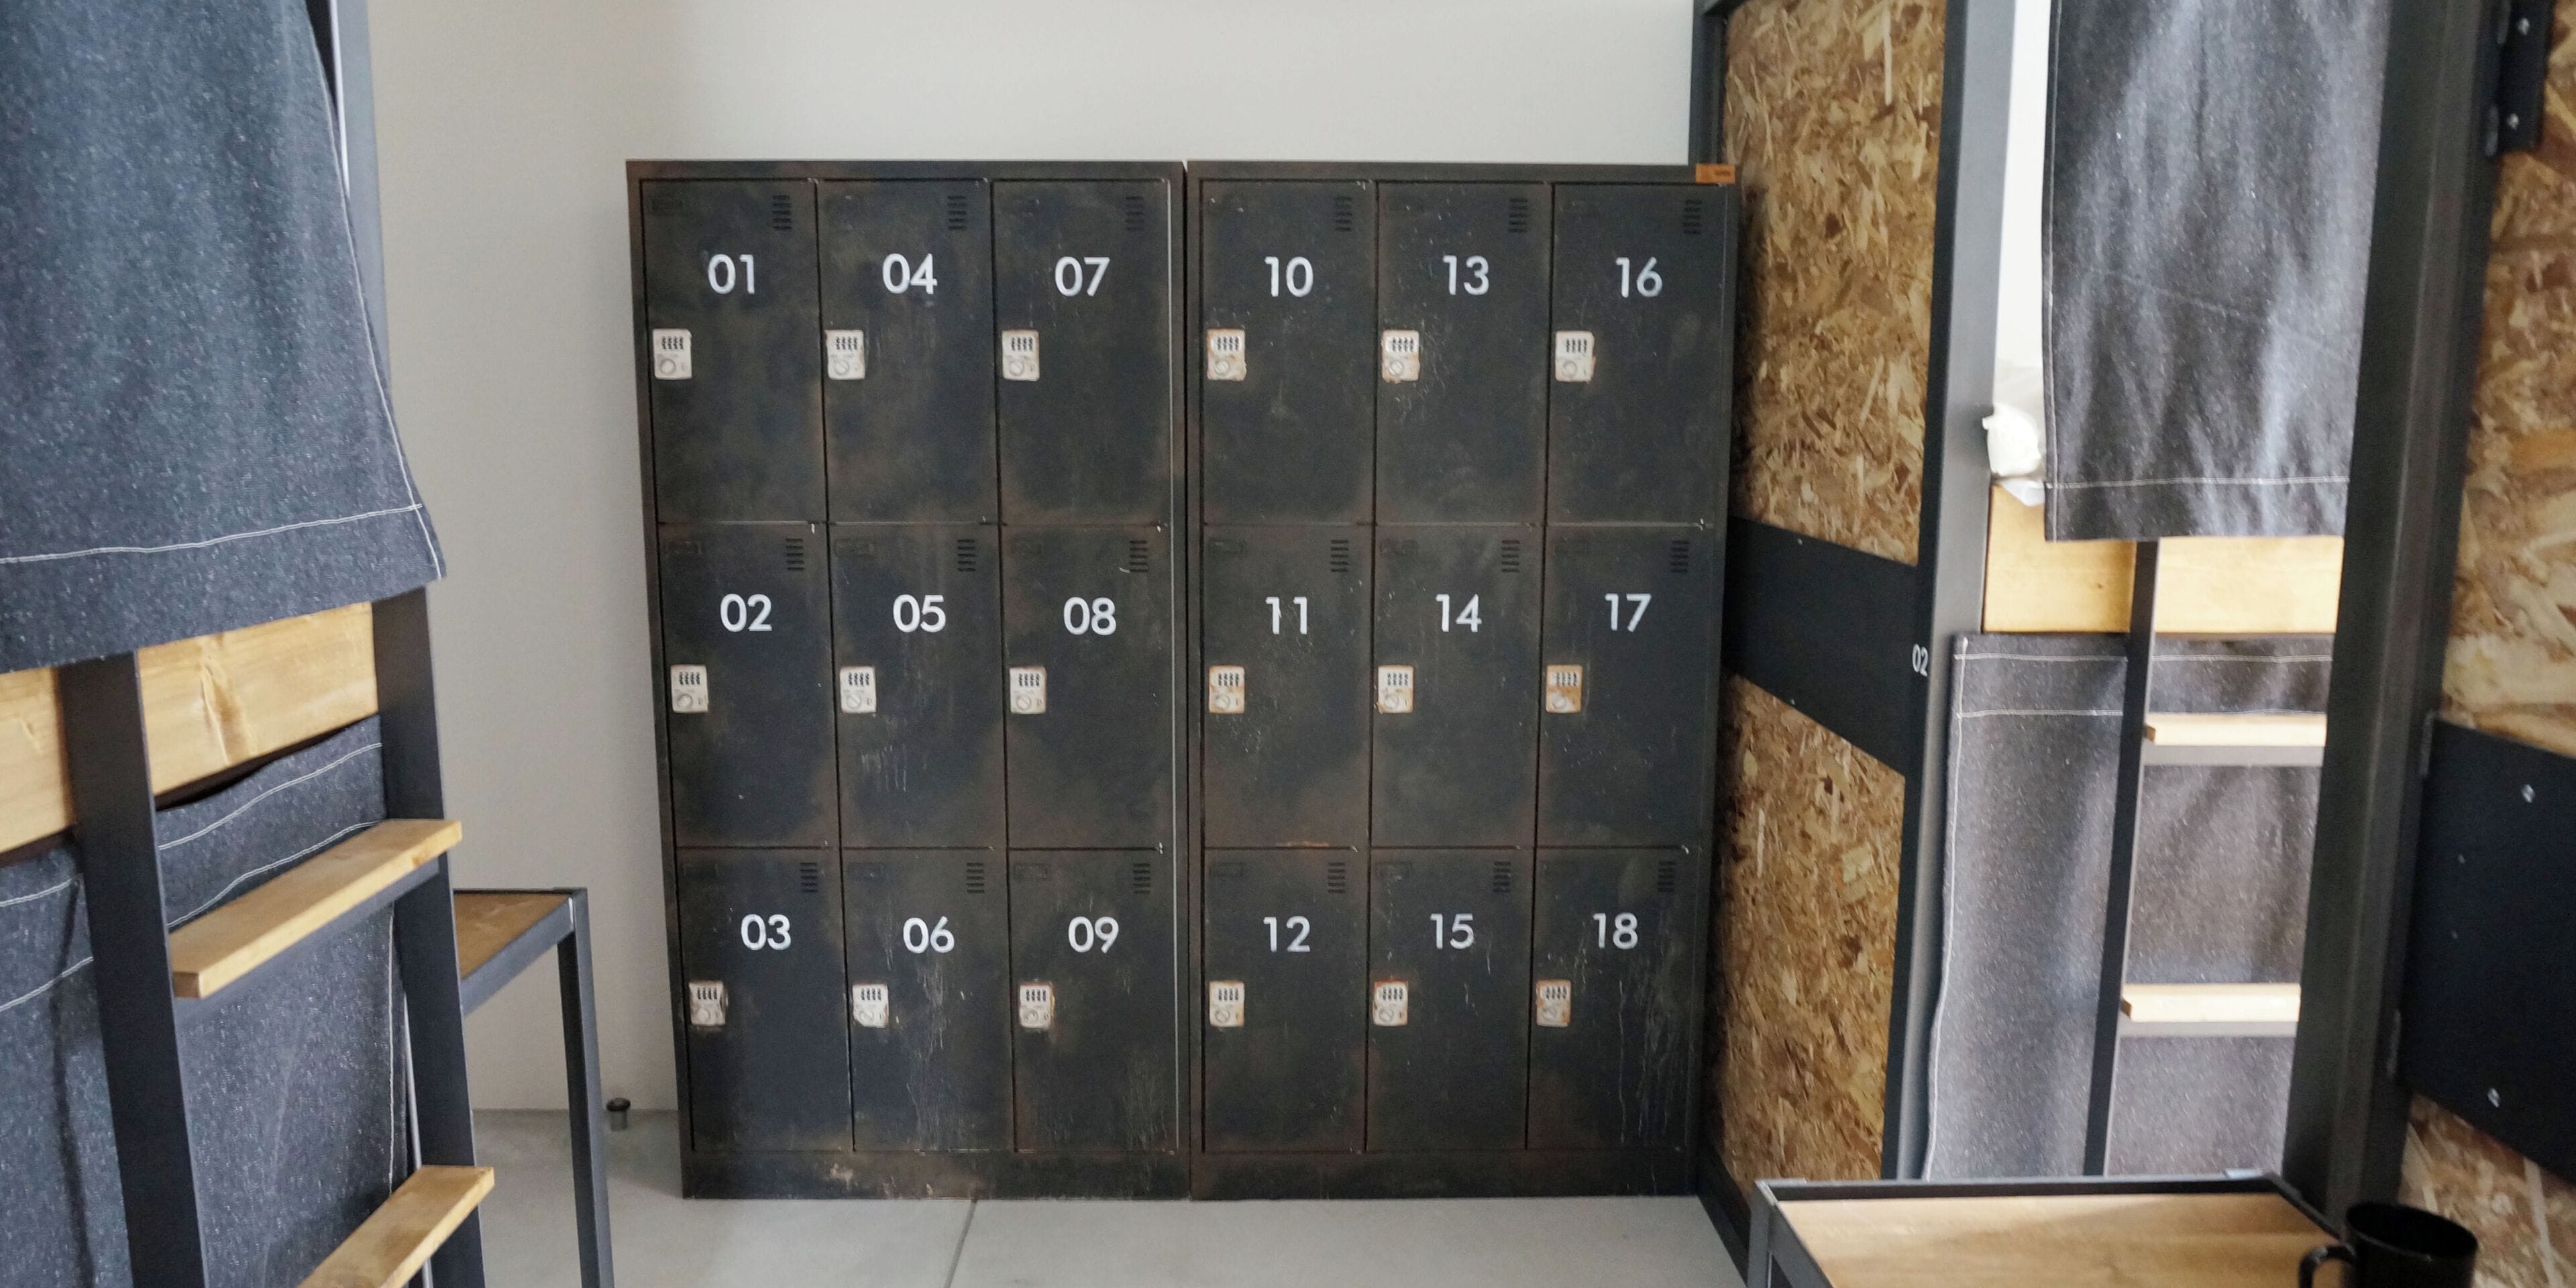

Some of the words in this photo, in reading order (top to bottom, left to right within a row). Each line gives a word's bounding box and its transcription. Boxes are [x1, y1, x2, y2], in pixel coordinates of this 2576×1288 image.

[708, 254, 755, 294] 01
[883, 254, 937, 294] 04
[1055, 257, 1110, 296] 07
[1265, 256, 1313, 297] 10
[1443, 256, 1489, 295] 13
[1616, 257, 1662, 297] 16
[720, 594, 771, 632] 02
[893, 594, 946, 633] 05
[1064, 597, 1116, 635] 08
[1266, 596, 1307, 635] 11
[1436, 594, 1482, 632] 14
[1605, 594, 1651, 631] 17
[1912, 643, 1929, 677] 02
[741, 914, 791, 950] 03
[903, 916, 955, 953] 06
[1069, 916, 1119, 953] 09
[1263, 916, 1310, 952] 12
[1430, 914, 1474, 949] 15
[1593, 914, 1638, 949] 18
